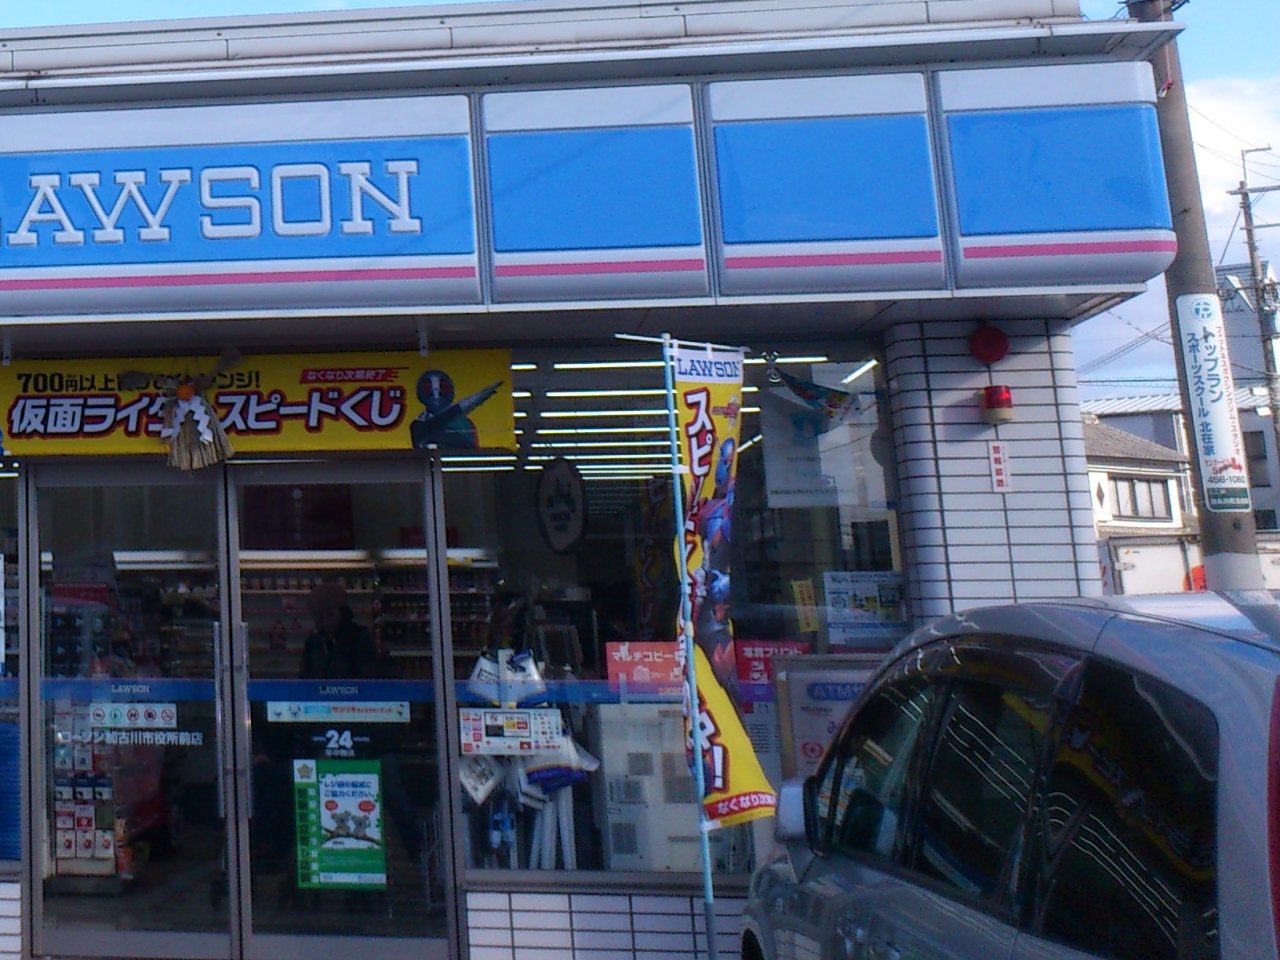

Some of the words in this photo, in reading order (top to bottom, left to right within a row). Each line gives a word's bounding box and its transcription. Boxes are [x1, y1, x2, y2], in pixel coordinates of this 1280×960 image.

[677, 358, 741, 378] LAWSON
[1186, 332, 1210, 418] スポーツスクール
[1202, 326, 1223, 403] トップラン
[325, 728, 354, 749] 24
